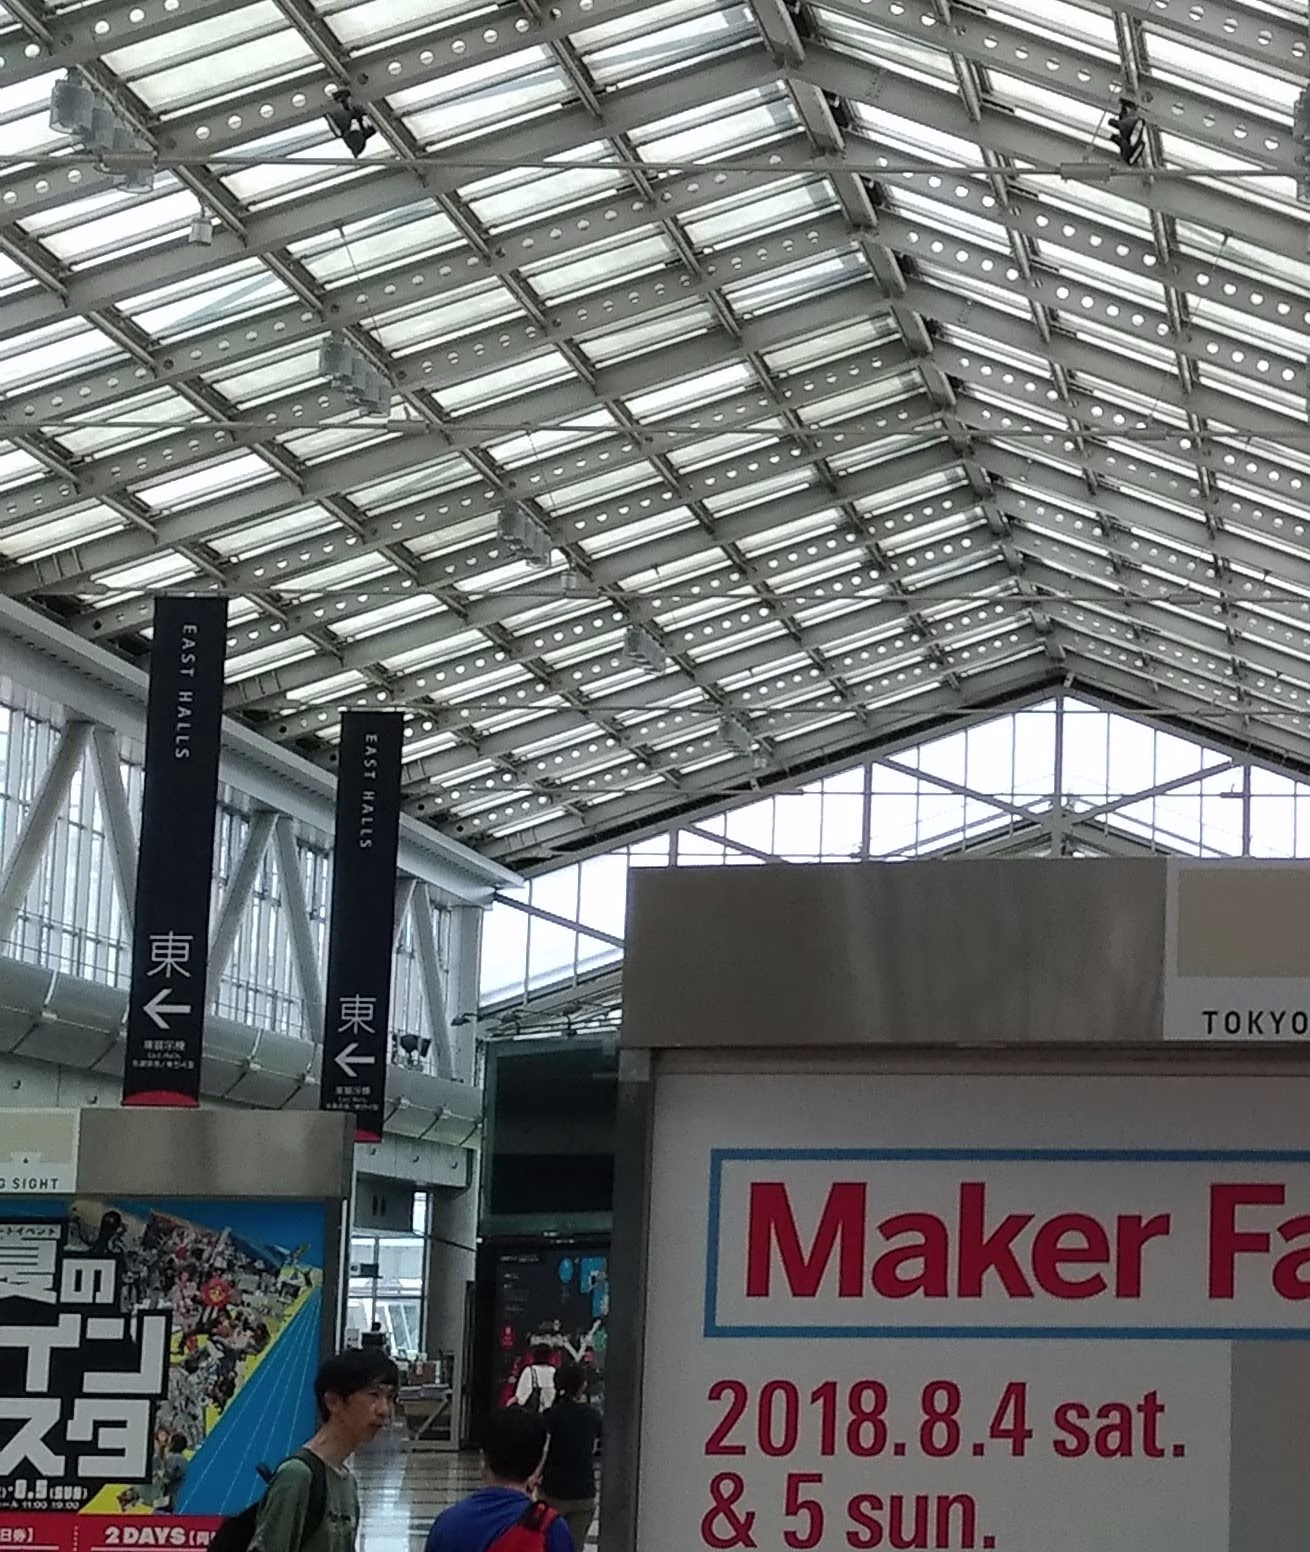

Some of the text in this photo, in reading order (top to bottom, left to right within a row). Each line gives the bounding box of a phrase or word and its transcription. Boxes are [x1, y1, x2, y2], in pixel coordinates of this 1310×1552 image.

[174, 624, 197, 760] EAST HALLS
[360, 734, 378, 848] EAST HALLS
[147, 930, 193, 978] 東
[338, 993, 376, 1034] 東
[1202, 1010, 1309, 1035] TOKYO
[12, 1177, 59, 1190] SIGHT
[746, 1181, 1171, 1299] Maker
[704, 1379, 1186, 1458] 2018.8.4 sat.
[105, 1526, 121, 1545] 2
[123, 1526, 187, 1545] DAYS
[700, 1472, 996, 1550] & 5 sun.
